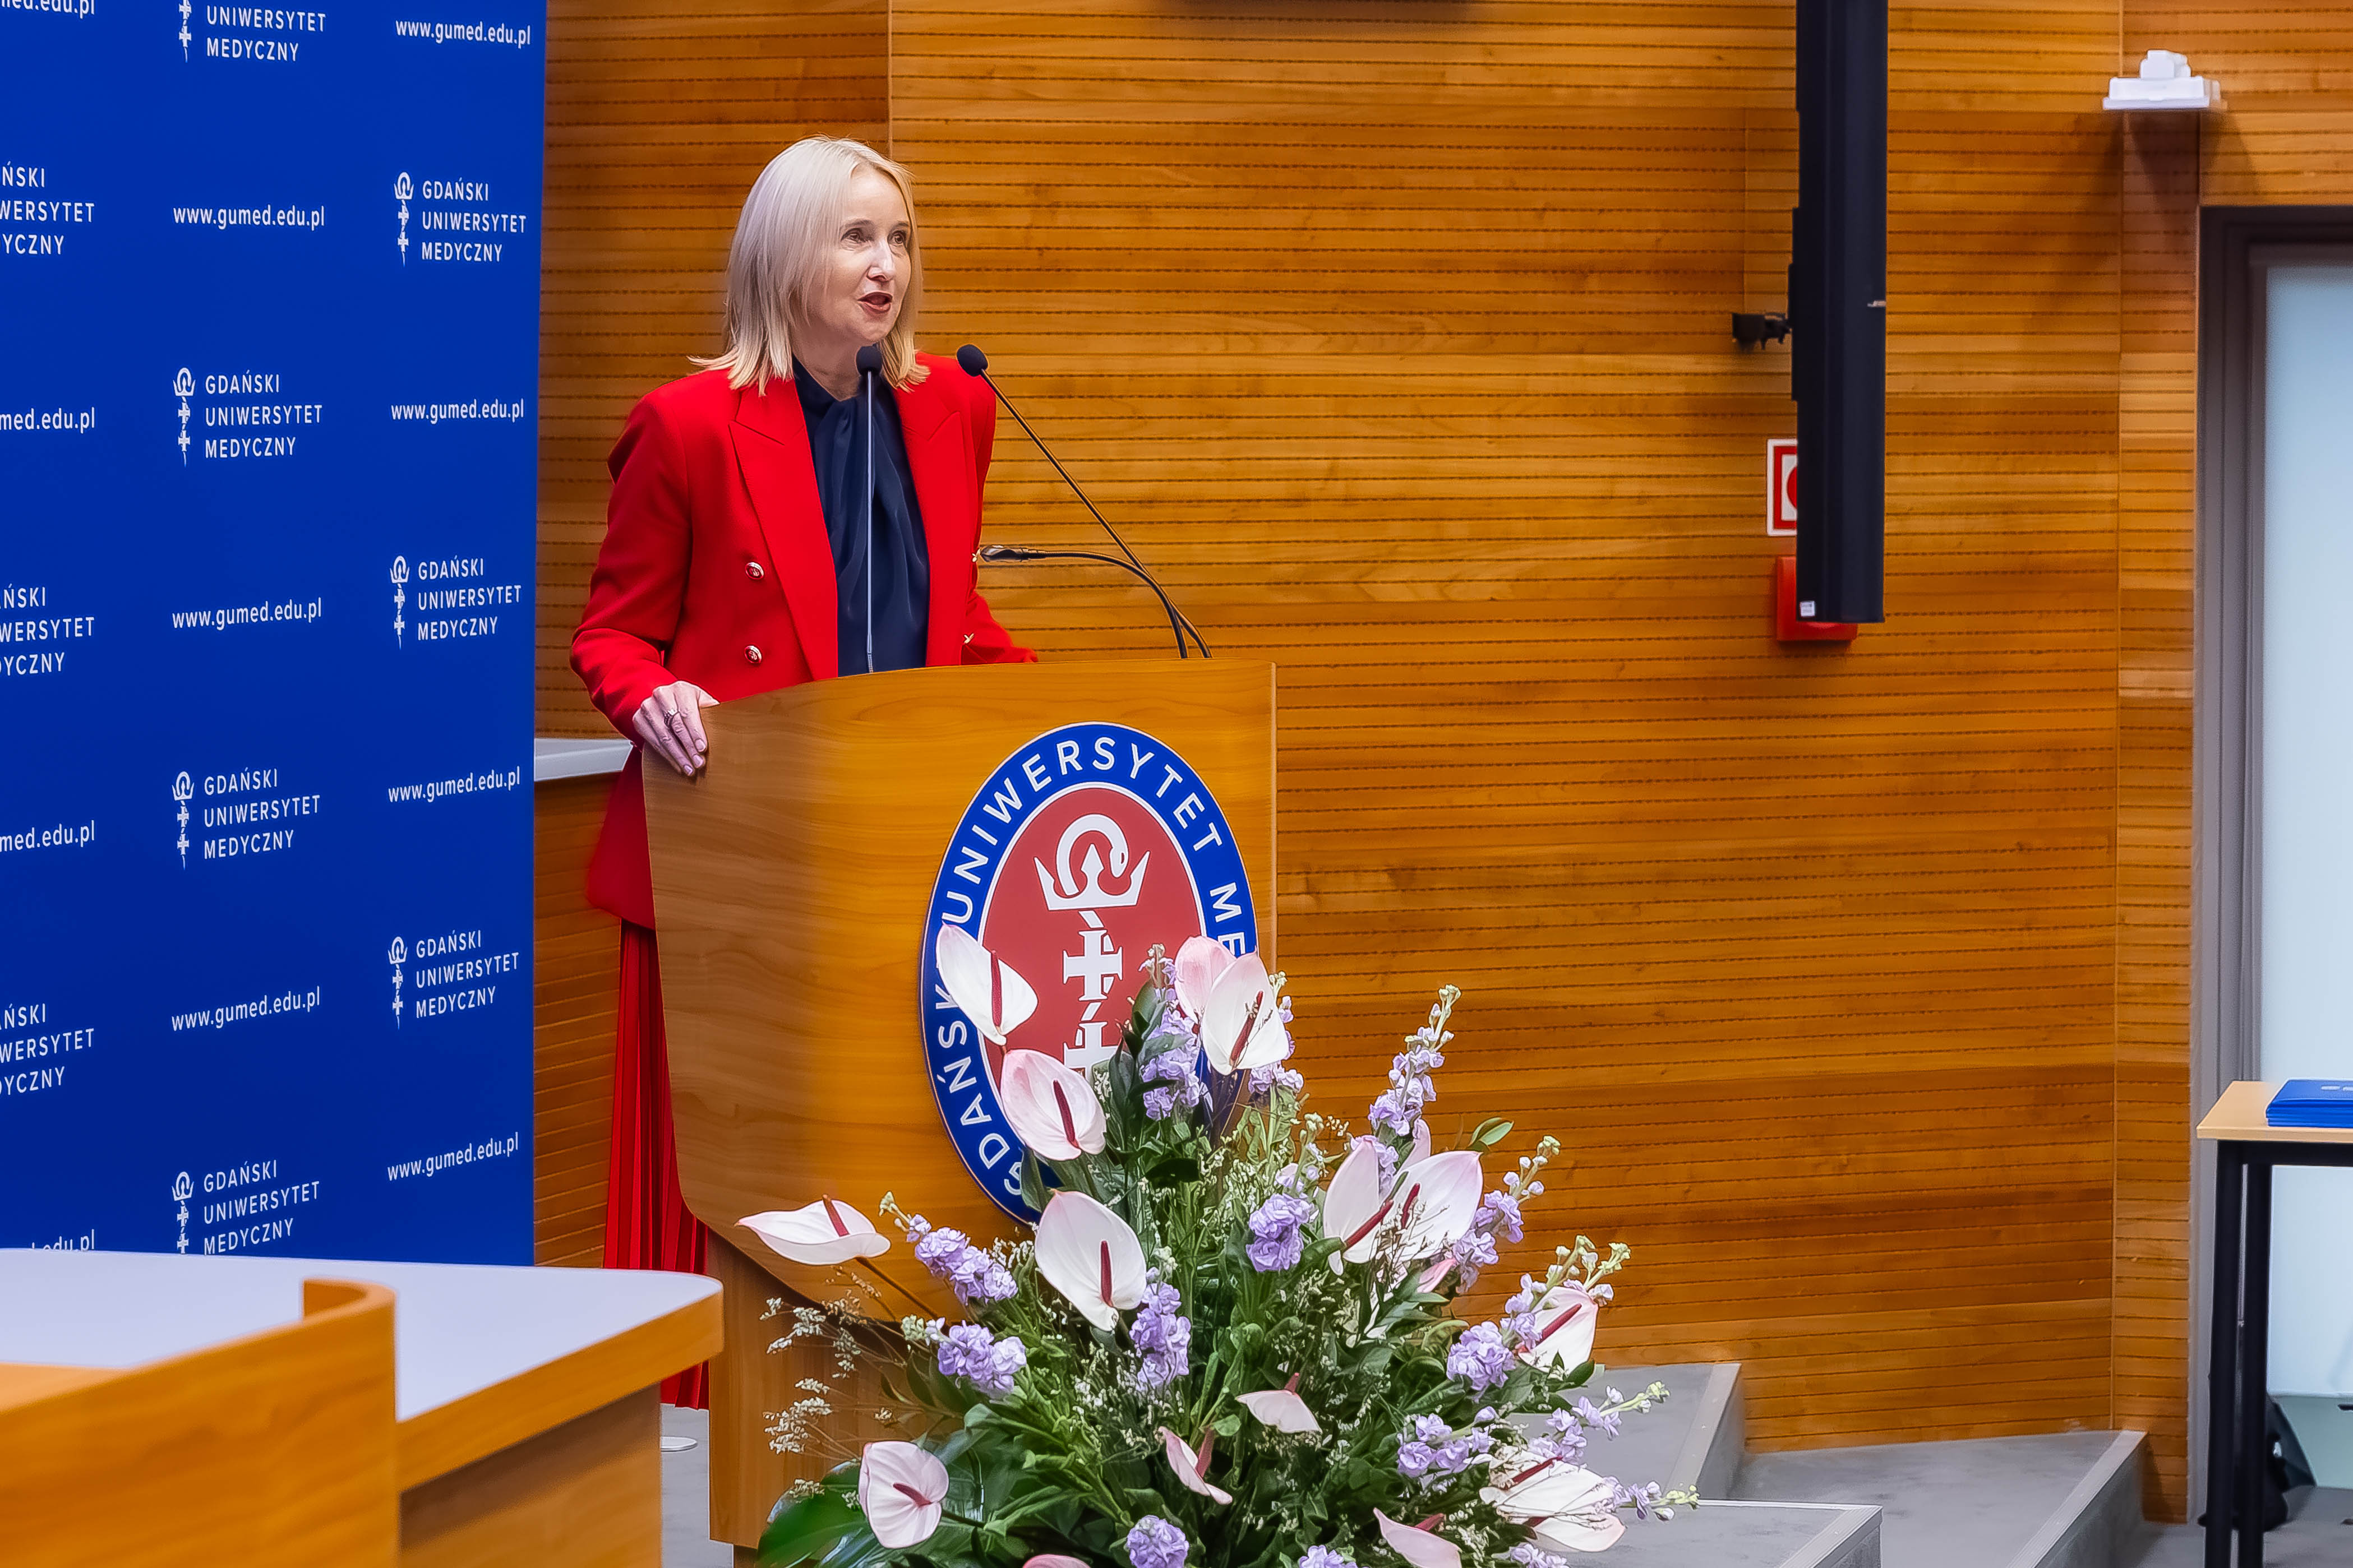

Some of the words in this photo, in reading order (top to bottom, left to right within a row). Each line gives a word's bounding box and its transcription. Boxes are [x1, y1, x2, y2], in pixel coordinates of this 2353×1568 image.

[207, 5, 326, 32] UNIWERSYTET
[395, 20, 530, 49] www.gumed.edu.pl
[207, 37, 299, 62] MEDYCZNY
[422, 177, 488, 201] GDAŃSKI
[173, 204, 324, 232] www.gumed.edu.pl
[422, 211, 527, 233] UNIWERSYTET
[422, 242, 502, 262] MEDYCZNY
[205, 369, 279, 395] GDAŃSKI
[205, 404, 322, 427] UNIWERSYTET
[391, 398, 524, 424] www.gumed.edu.pl
[205, 436, 296, 459] MEDYCZNY
[418, 555, 483, 580] GDAŃSKI
[0, 583, 45, 609] ŃSKI
[418, 585, 522, 610] UNIWERSYTET
[172, 596, 321, 631] www.gumed.edu.pl
[418, 616, 498, 641] MEDYCZNY
[0, 652, 64, 676] YCZNY
[204, 767, 277, 795] GDAŃSKI
[388, 766, 520, 803] www.gumed.edu.pl
[204, 794, 320, 827] UNIWERSYTET
[204, 829, 294, 859] MEDYCZNY
[942, 737, 1222, 924] UNIWERSYTET
[416, 929, 481, 958] GDAŃSKI
[416, 952, 519, 988] UNIWERSYTET
[0, 1003, 45, 1030] ŃSKI
[171, 986, 320, 1032] www.gumed.edu.pl
[416, 986, 496, 1019] MEDYCZNY
[0, 1066, 65, 1095] YCZNY
[935, 964, 1023, 1195] GDAŃSK
[387, 1131, 518, 1181] www.gumed.edu.pl
[204, 1159, 276, 1193] GDAŃSKI
[204, 1181, 320, 1224] UNIWERSYTET
[204, 1218, 293, 1255] MEDYCZNY
